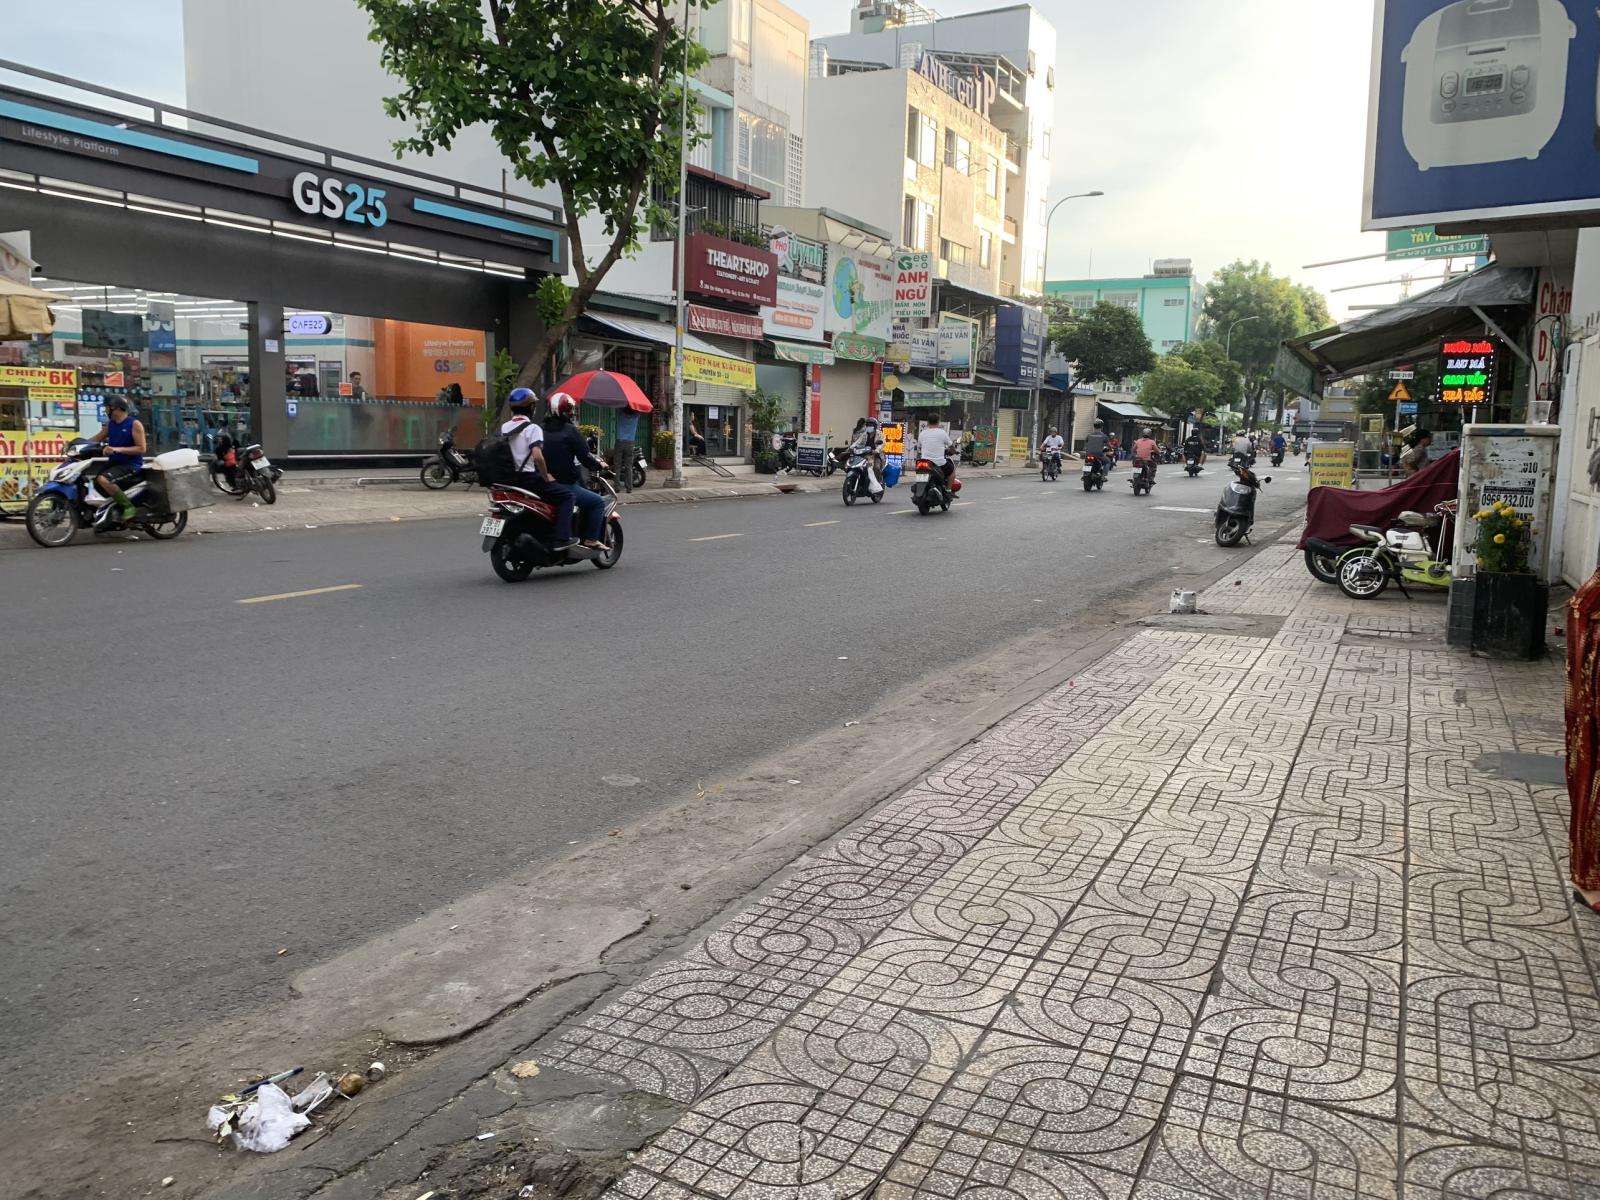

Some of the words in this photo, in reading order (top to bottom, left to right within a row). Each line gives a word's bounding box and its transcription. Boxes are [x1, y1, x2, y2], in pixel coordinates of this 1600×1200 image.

[21, 126, 70, 145] Lifestyle
[73, 138, 119, 156] Platform
[292, 171, 388, 228] GS25
[707, 248, 769, 278] THEARTSHOP
[897, 271, 928, 283] ANH
[896, 285, 927, 301] NGỮ
[291, 319, 323, 330] CAFE25
[912, 338, 920, 346] AI
[49, 370, 74, 386] 6K
[22, 433, 66, 463] CHIÊ
[1481, 493, 1535, 508] 0968232.010
